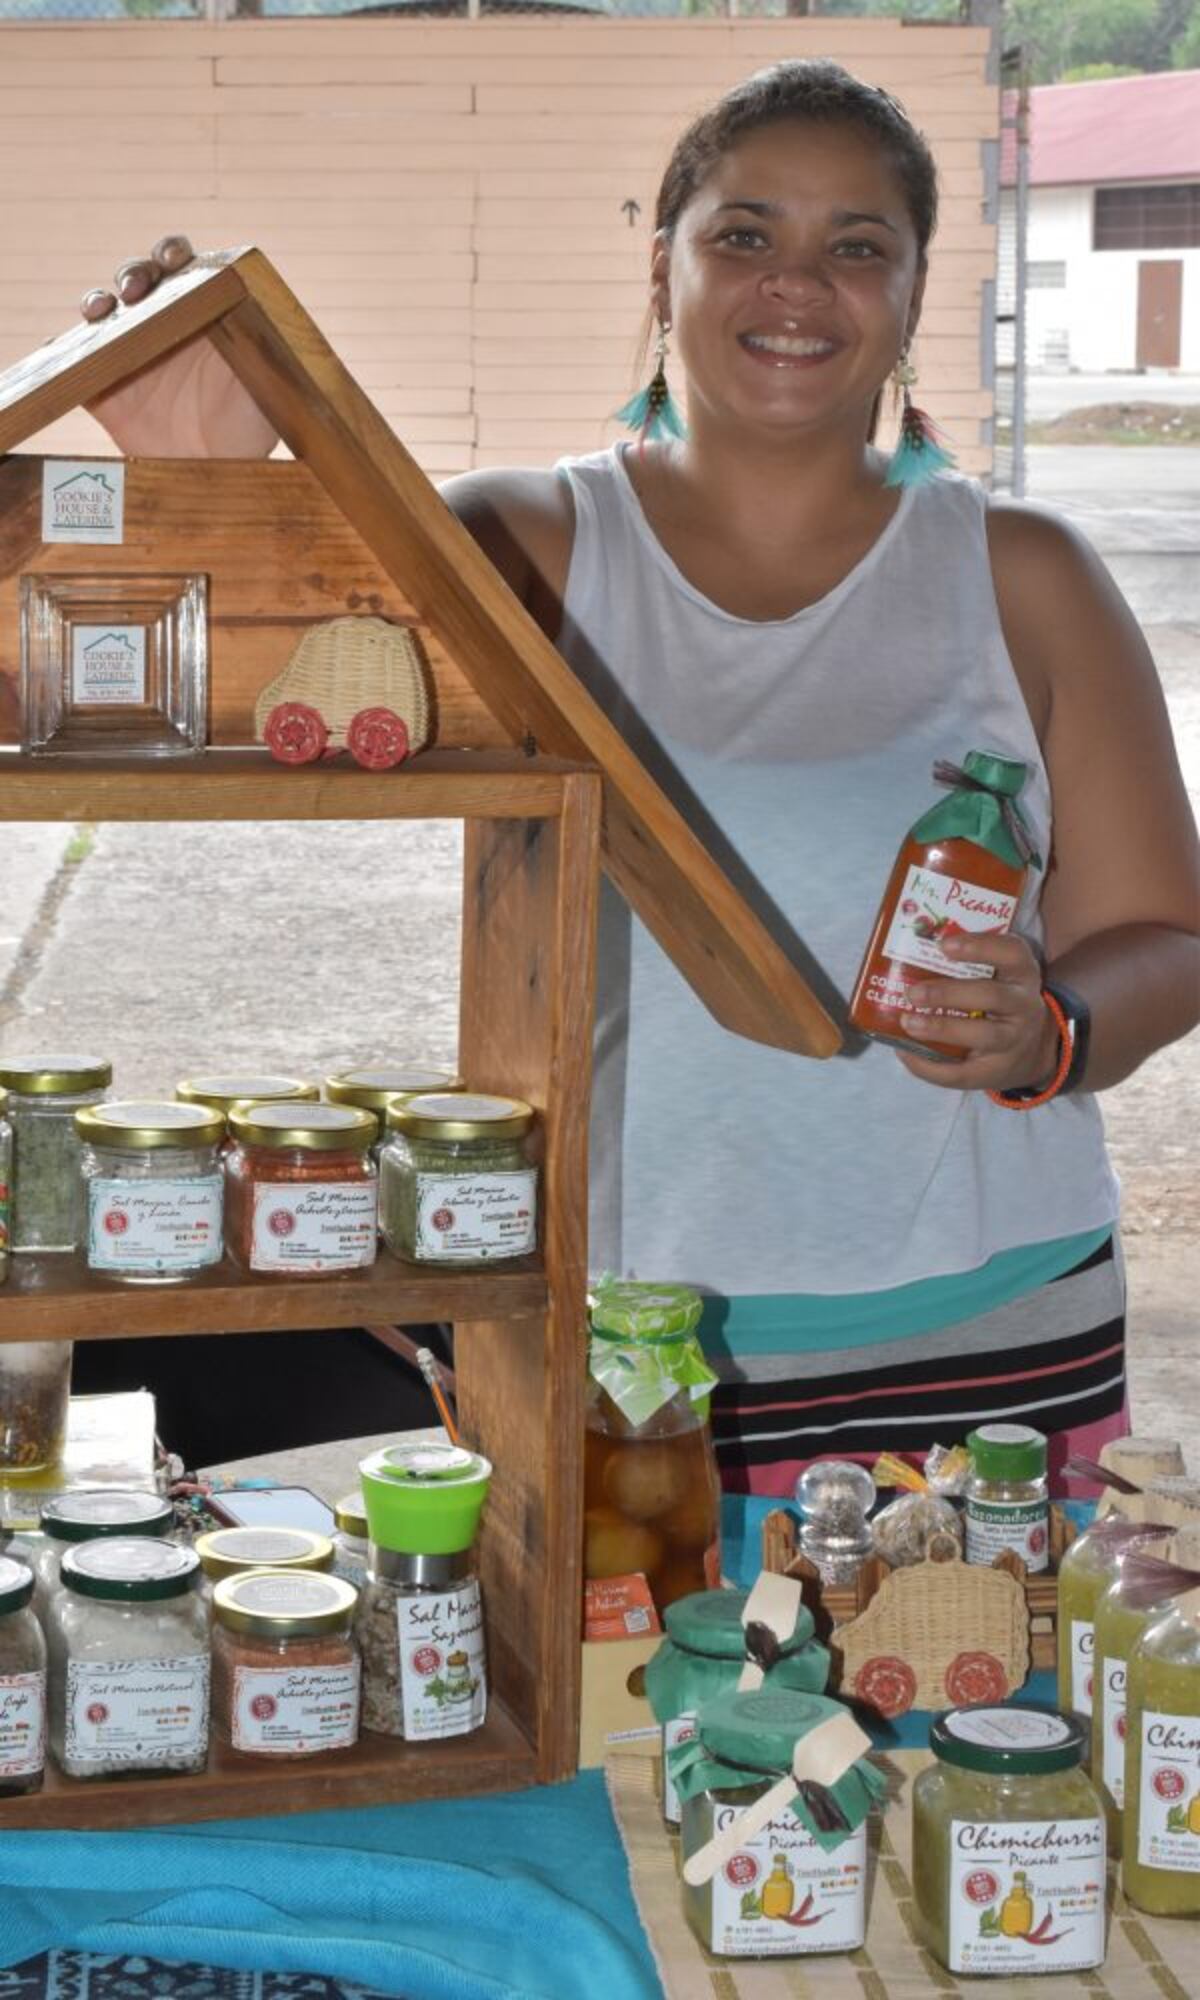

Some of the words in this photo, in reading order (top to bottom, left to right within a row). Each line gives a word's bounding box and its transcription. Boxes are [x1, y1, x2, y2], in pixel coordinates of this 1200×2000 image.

[52, 491, 113, 503] COOKIE'S
[55, 503, 97, 514] HOUSE
[55, 515, 113, 526] CATERING
[944, 879, 1012, 919] Picante
[305, 1191, 327, 1204] Sal
[408, 1603, 441, 1625] Sal
[769, 1834, 816, 1849] Picant
[957, 1823, 1100, 1850] Chimichurri
[1009, 1851, 1059, 1867] Picante
